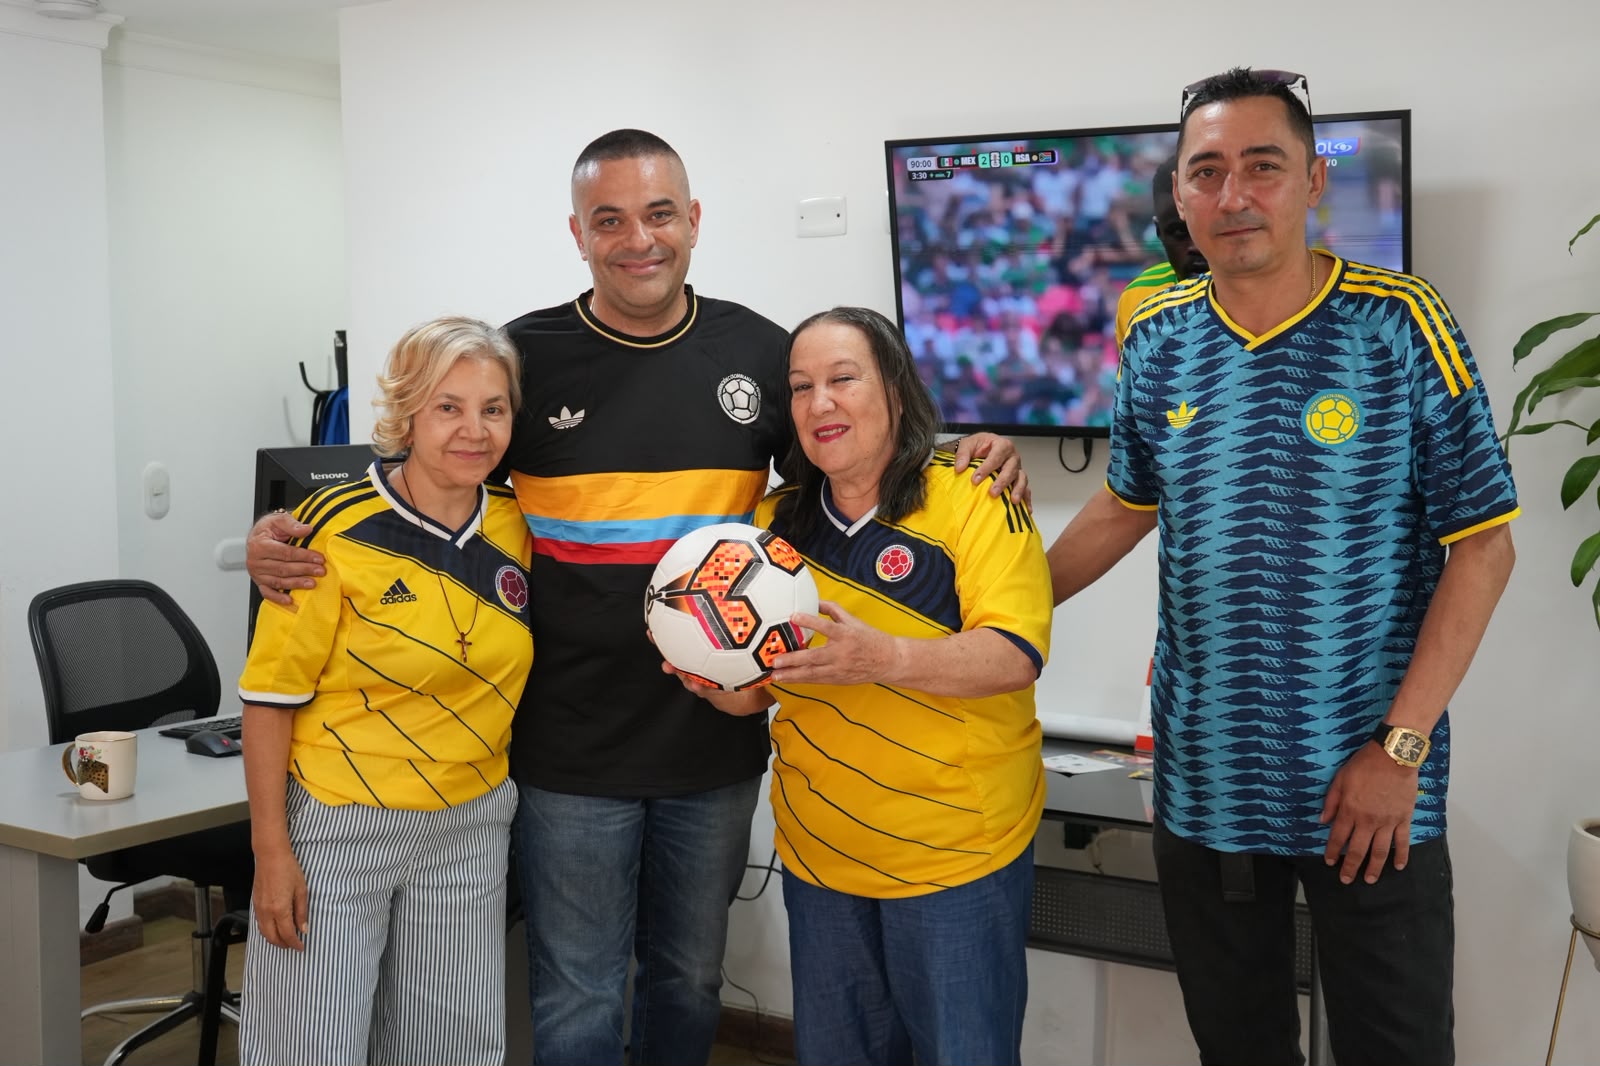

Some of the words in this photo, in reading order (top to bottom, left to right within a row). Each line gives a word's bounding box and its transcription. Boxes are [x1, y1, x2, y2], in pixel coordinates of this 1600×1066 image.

[910, 160, 932, 169] 90:00
[960, 156, 976, 166] MEX
[981, 156, 988, 165] 2
[1003, 154, 1010, 164] 0
[1015, 153, 1031, 163] RSA
[911, 172, 928, 180] 3:30
[310, 472, 349, 480] lenovo
[380, 593, 417, 605] adidas
